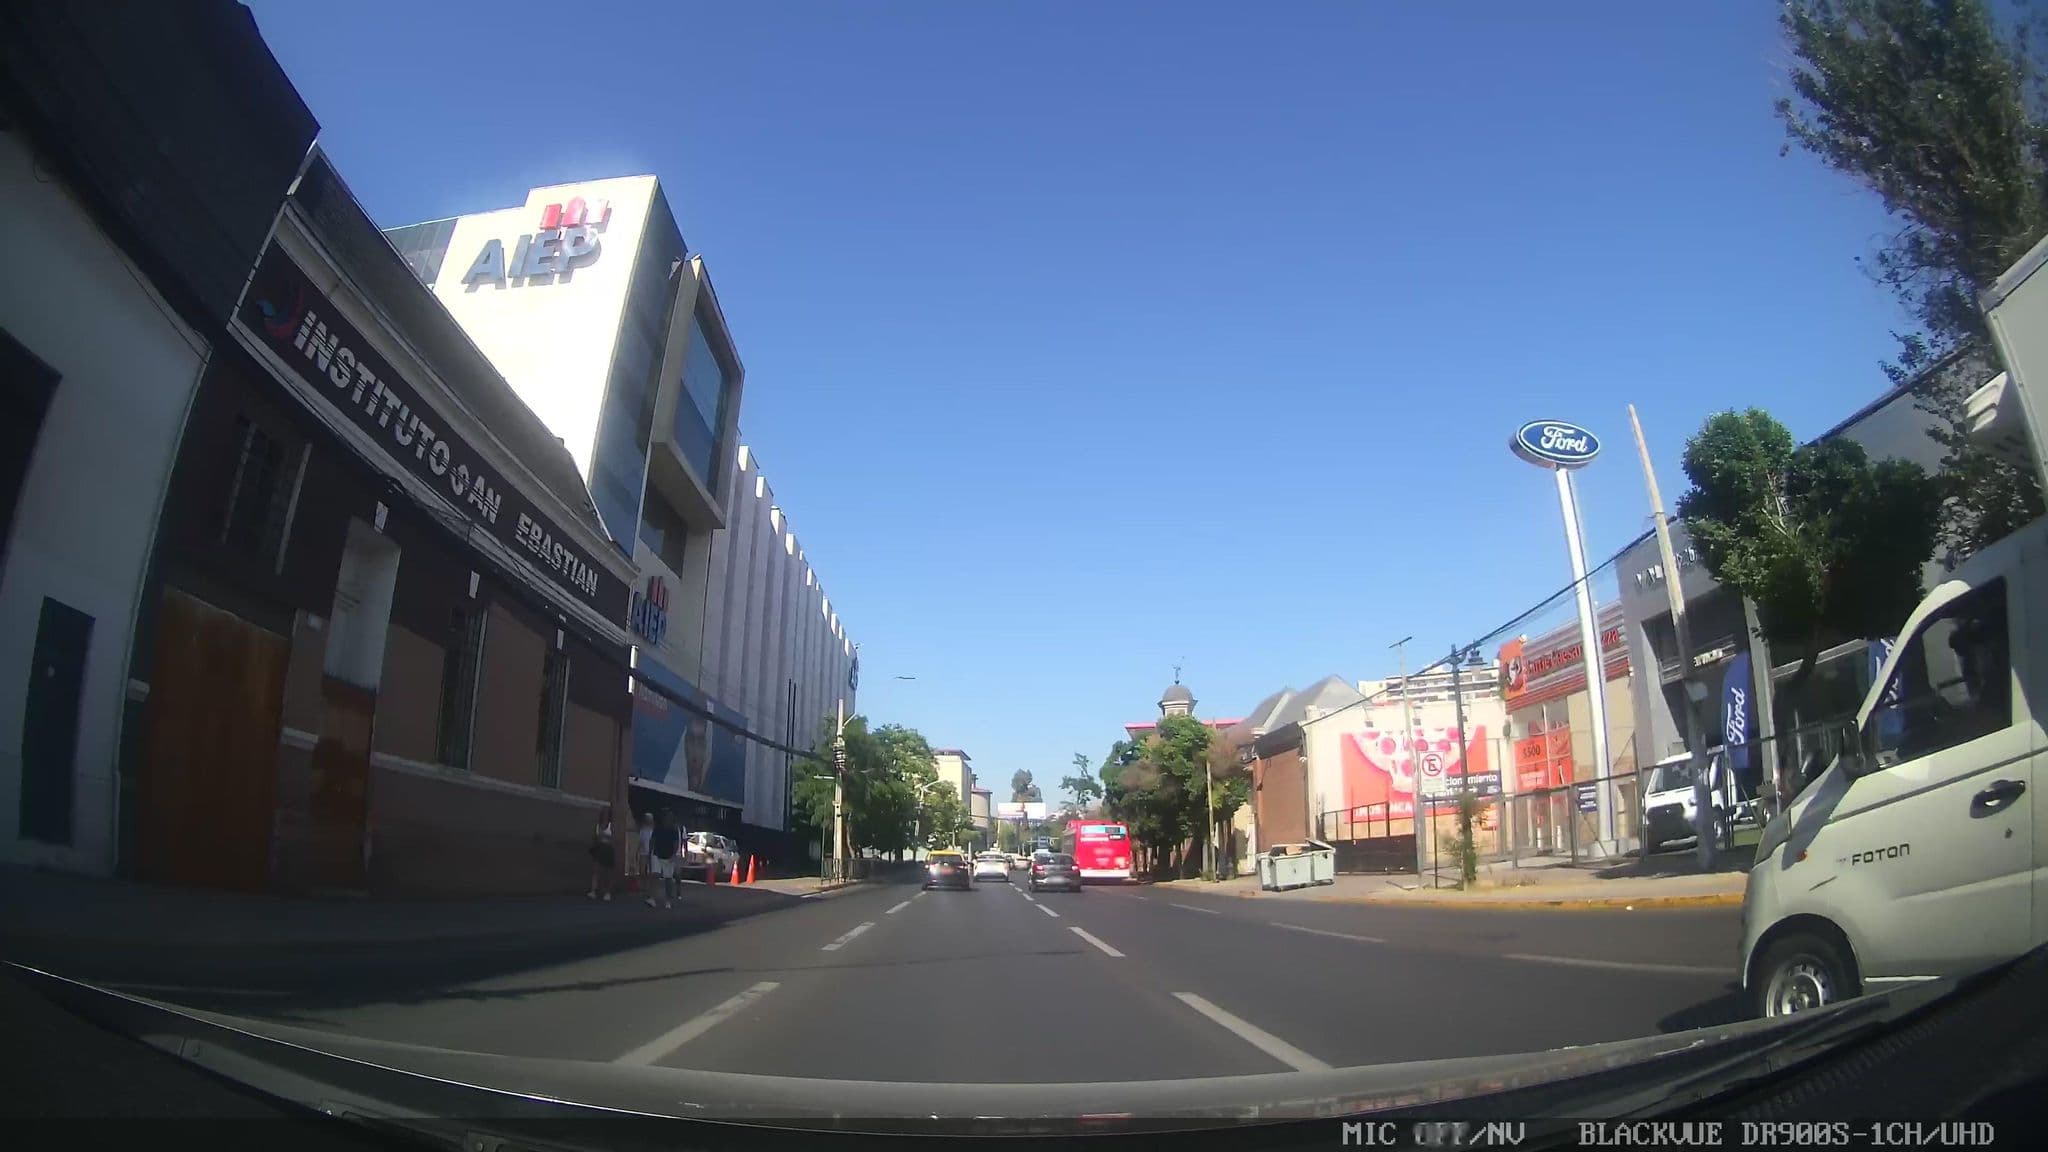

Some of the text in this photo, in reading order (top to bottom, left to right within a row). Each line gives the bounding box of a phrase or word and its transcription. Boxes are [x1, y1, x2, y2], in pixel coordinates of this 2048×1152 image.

[461, 227, 601, 290] AIEP
[294, 310, 450, 476] INSTITUTO
[1541, 426, 1588, 453] Ford
[1726, 686, 1746, 746] Ford
[1852, 843, 1910, 866] FOTON
